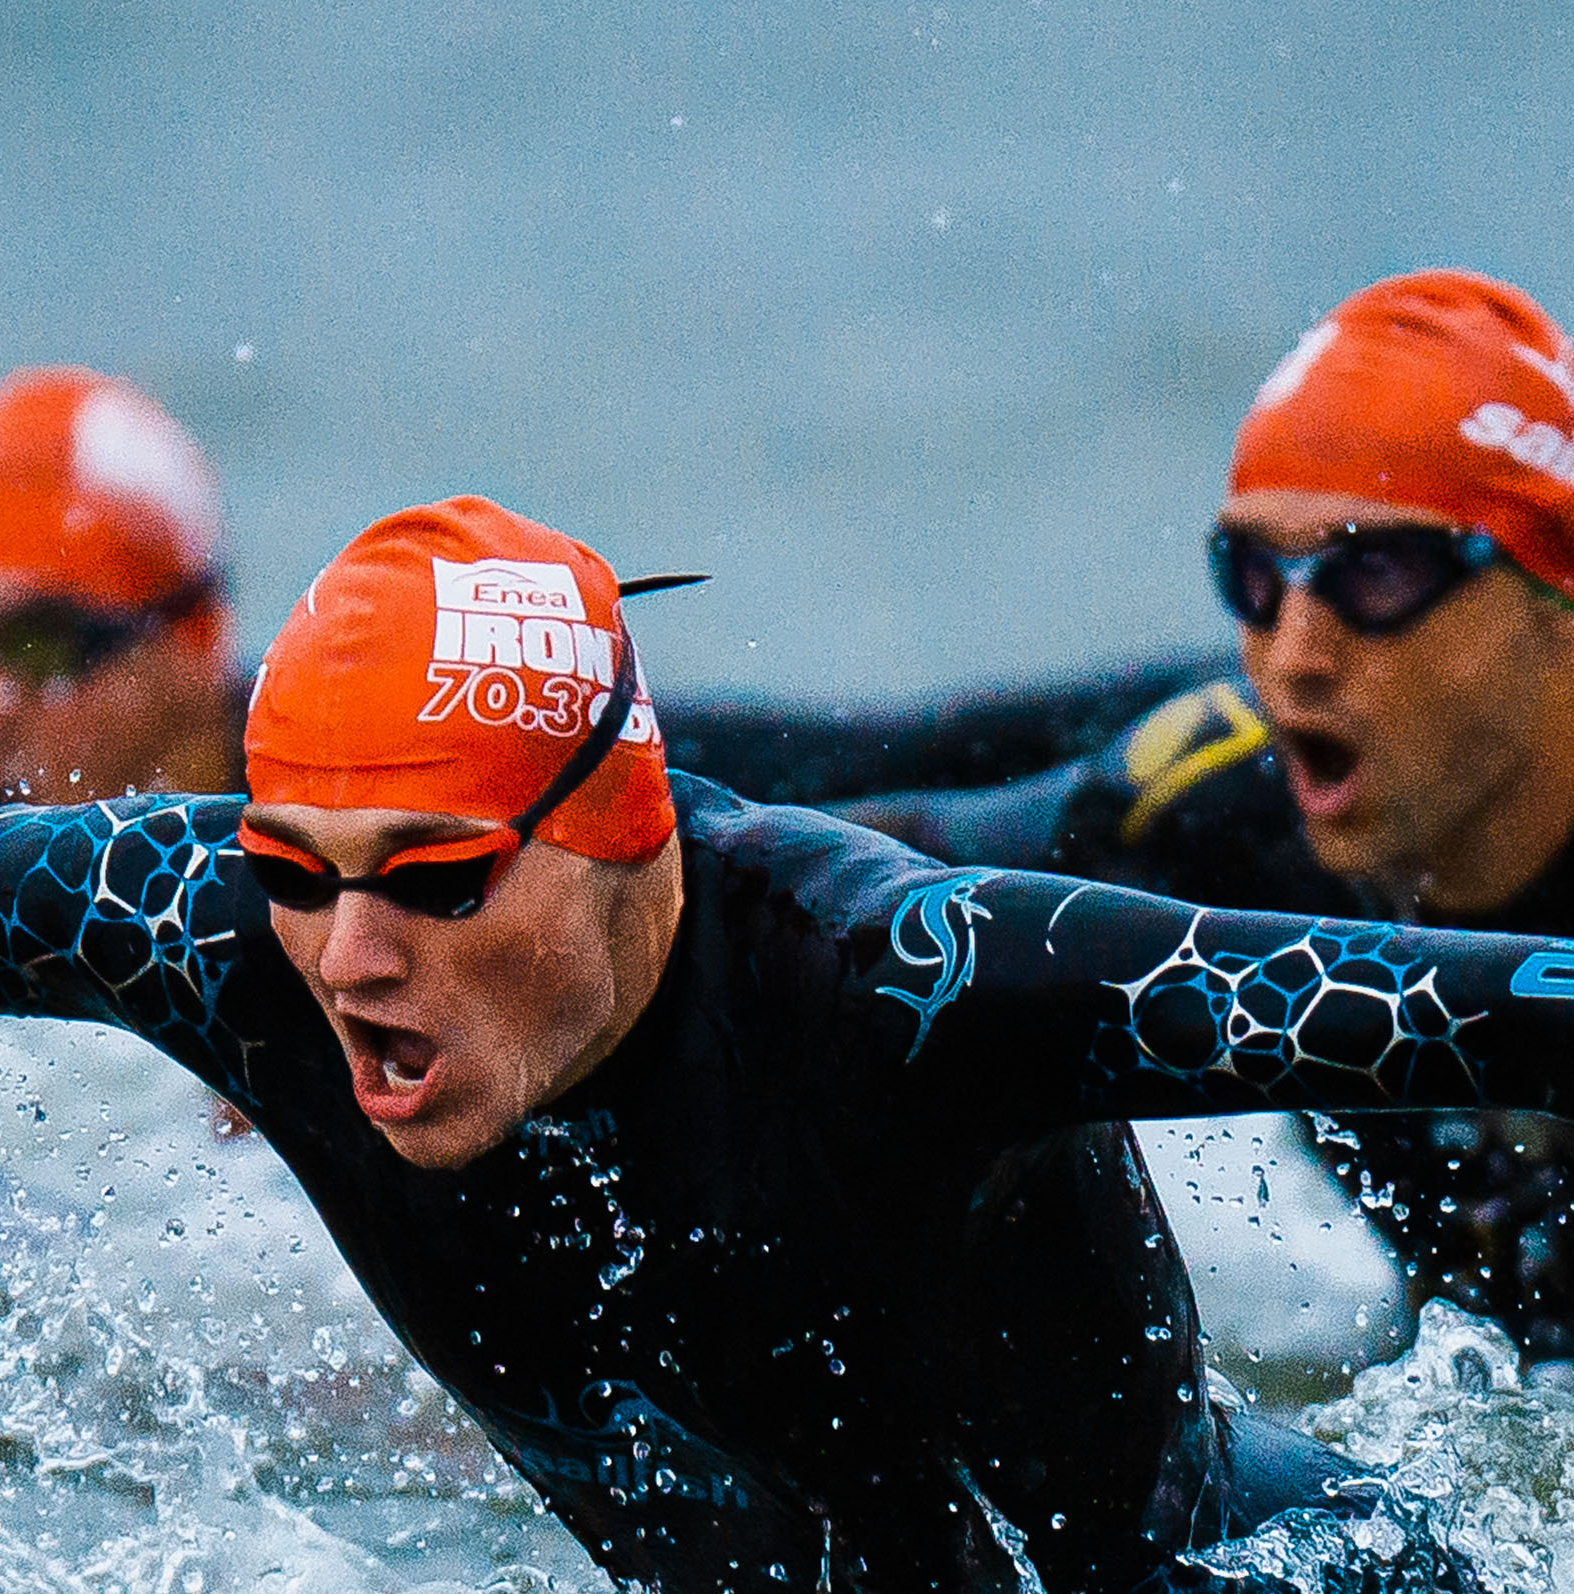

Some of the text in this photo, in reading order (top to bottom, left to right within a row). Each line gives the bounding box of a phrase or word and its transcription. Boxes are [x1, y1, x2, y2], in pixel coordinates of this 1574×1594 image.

[471, 583, 567, 608] Enea
[432, 610, 633, 692] IRON
[417, 662, 583, 738] 70.3
